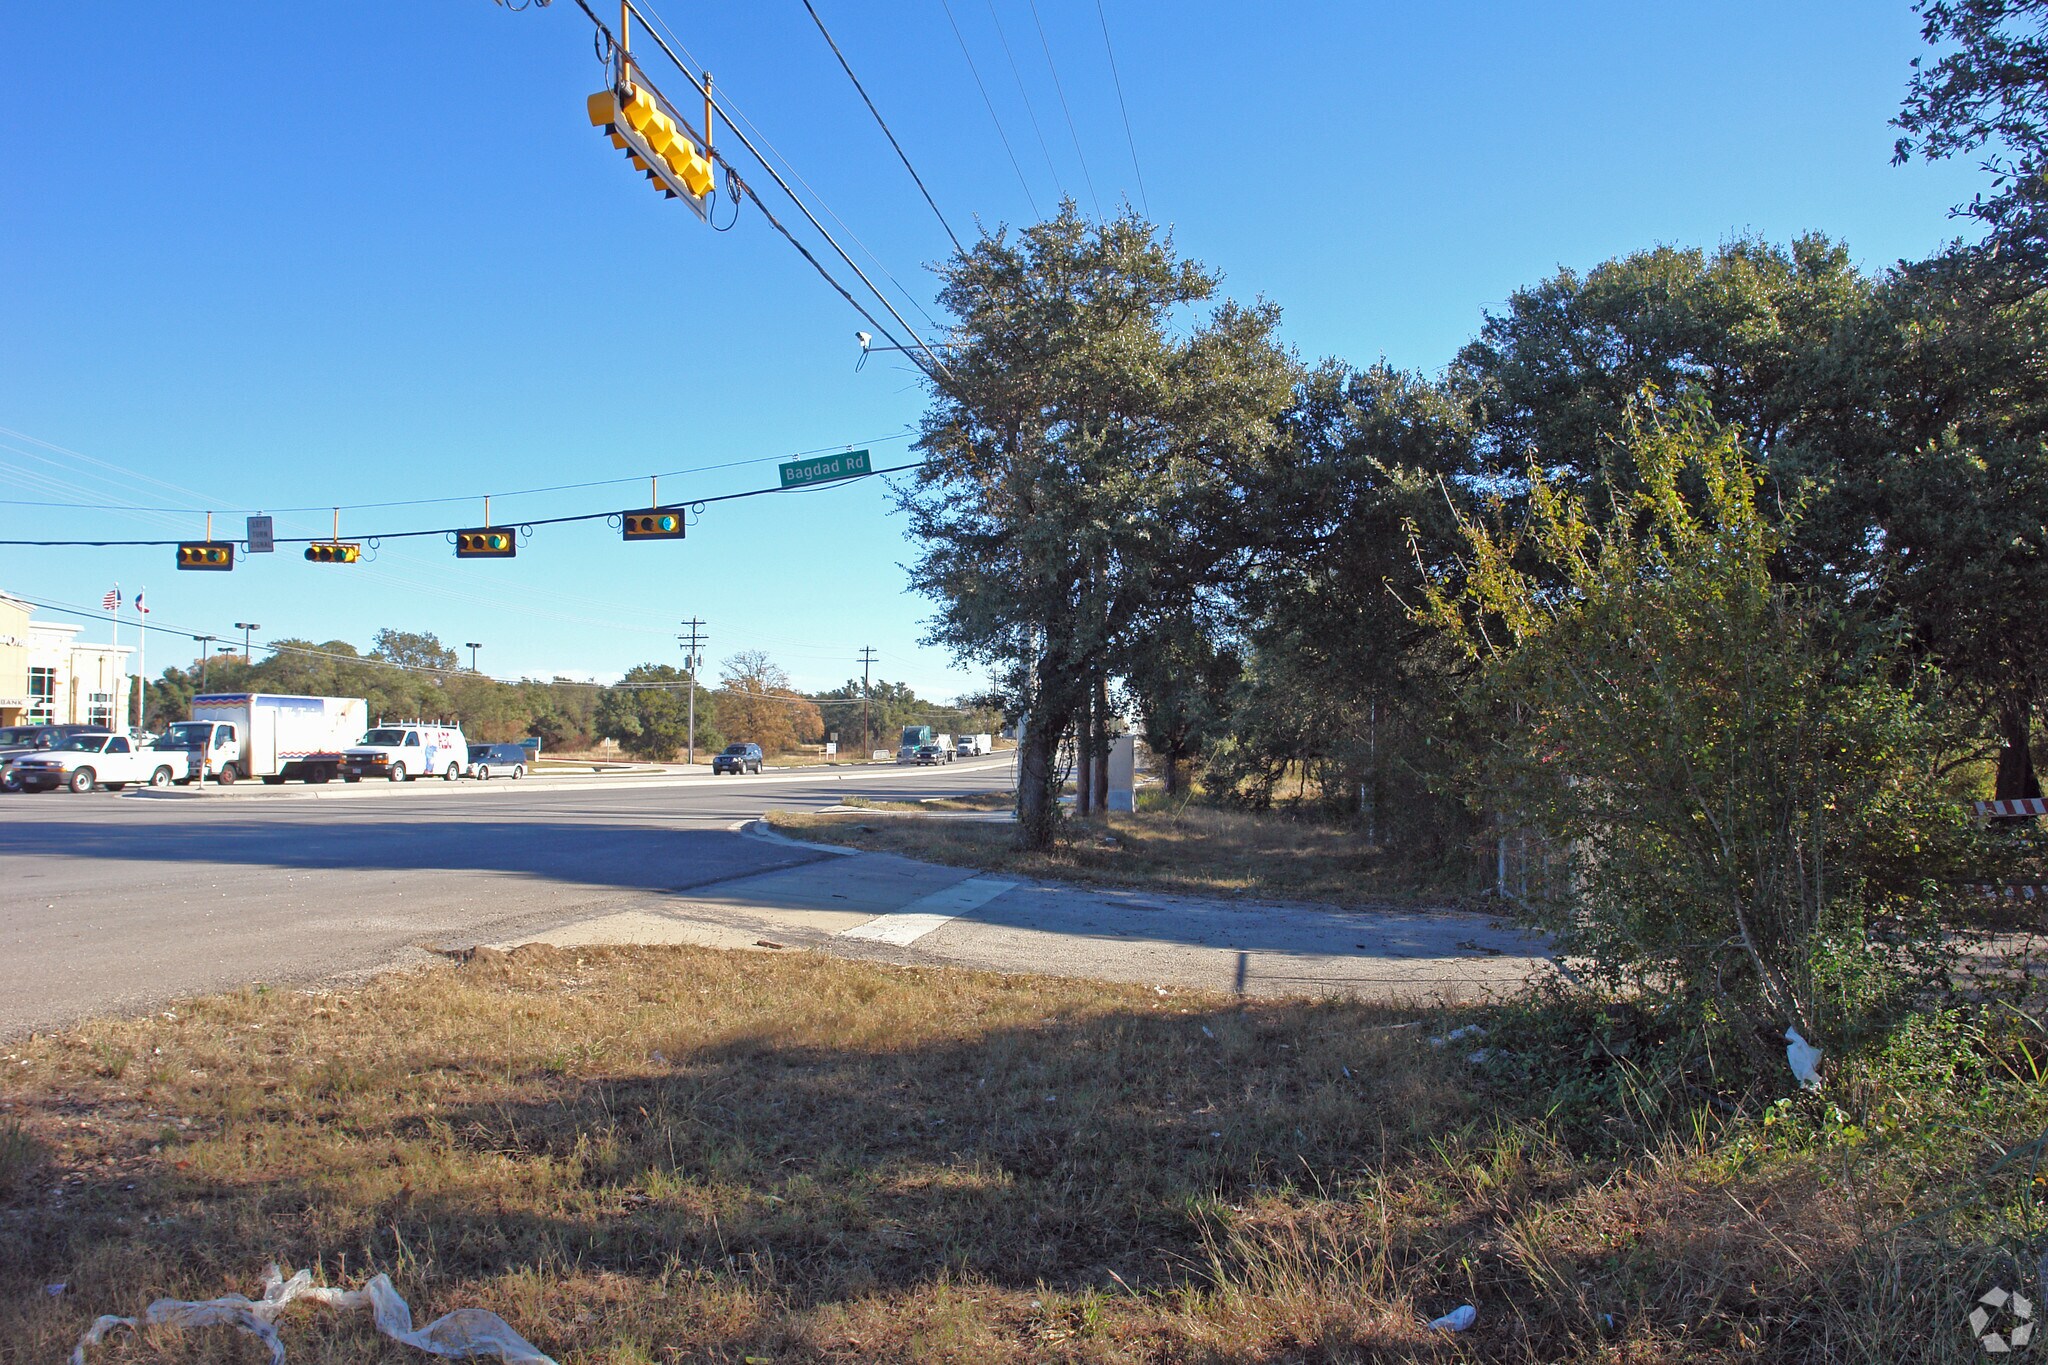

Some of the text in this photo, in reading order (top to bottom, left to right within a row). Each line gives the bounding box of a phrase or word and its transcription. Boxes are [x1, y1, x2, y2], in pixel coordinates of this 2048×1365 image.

[786, 456, 864, 480] Bagdad Rd
[250, 541, 273, 549] SIGNAL
